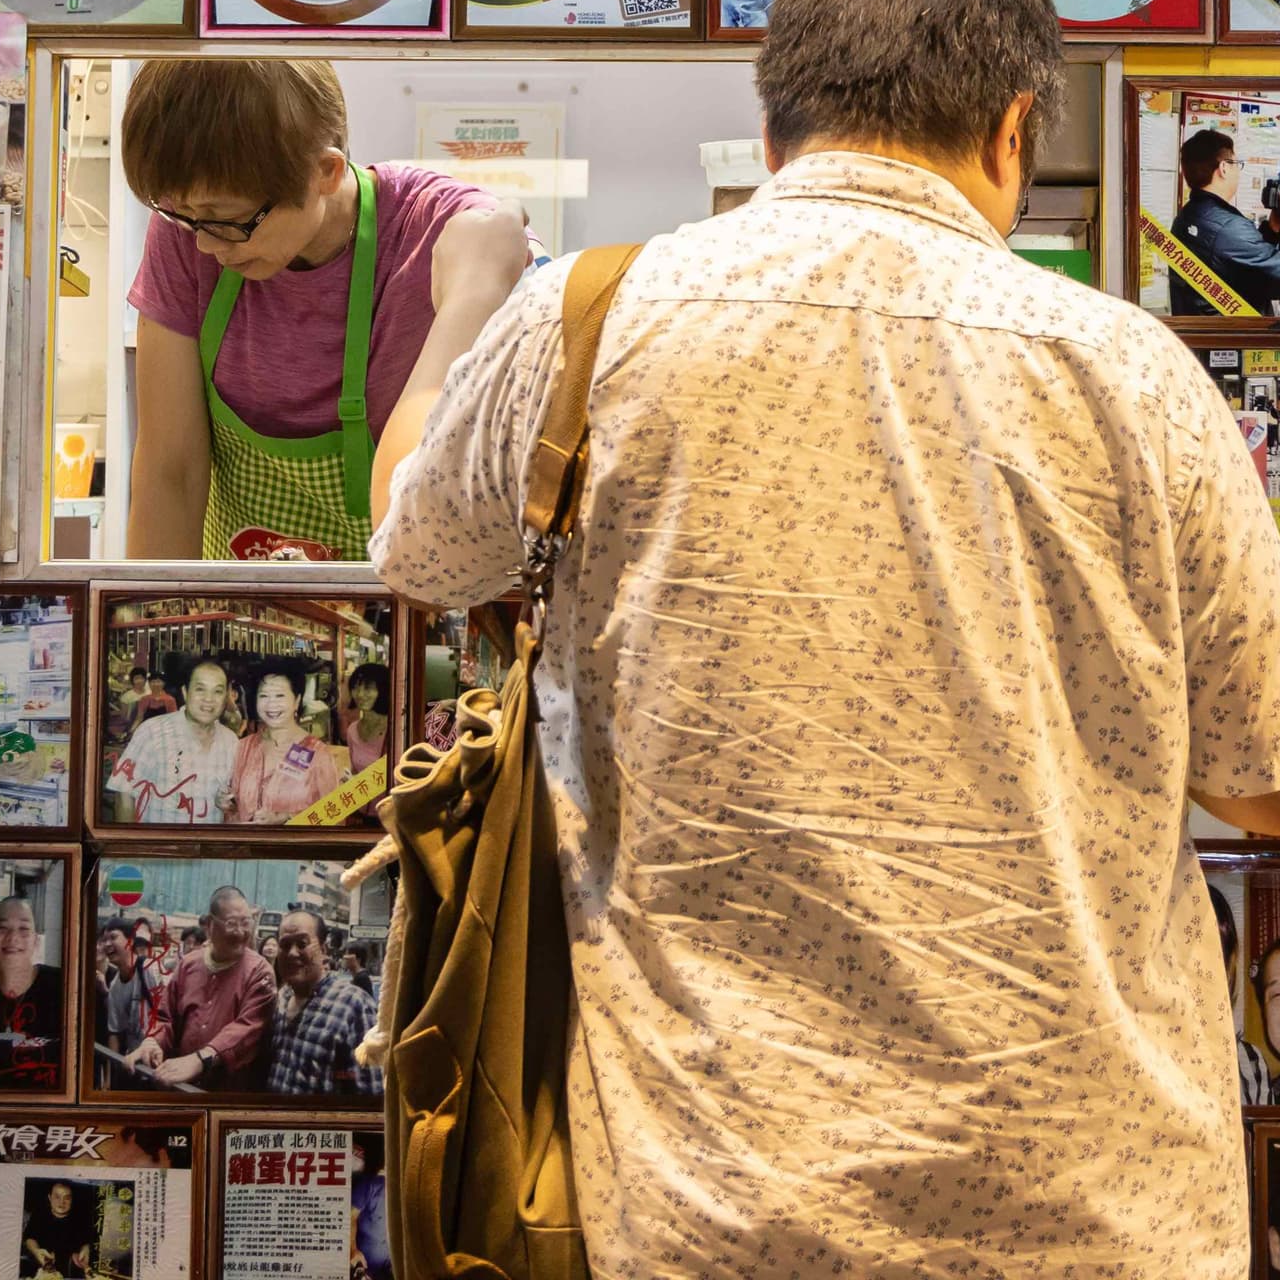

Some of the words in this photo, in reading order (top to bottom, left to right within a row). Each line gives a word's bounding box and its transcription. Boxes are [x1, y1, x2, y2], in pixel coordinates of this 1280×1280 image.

[290, 1132, 347, 1149] 北角長龍
[228, 1151, 347, 1186] 雞蛋仔王
